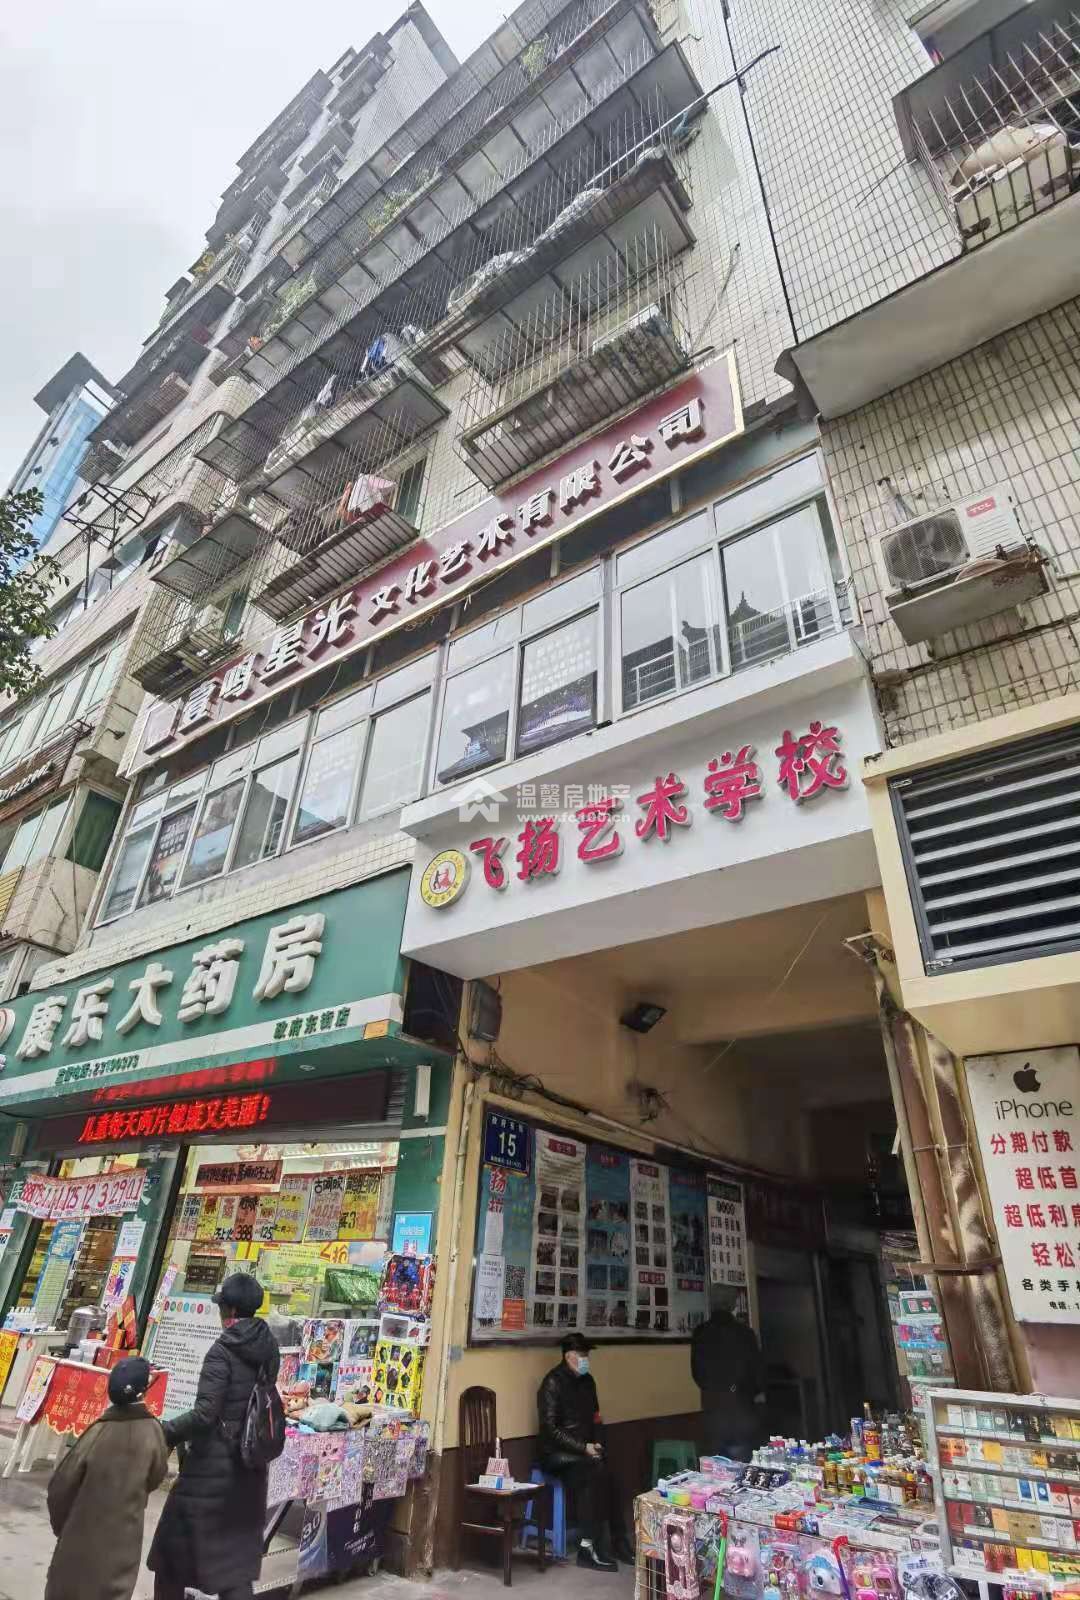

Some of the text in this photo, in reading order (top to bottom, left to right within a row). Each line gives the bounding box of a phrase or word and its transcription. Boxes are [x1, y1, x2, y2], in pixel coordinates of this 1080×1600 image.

[970, 502, 993, 514] TCL
[470, 721, 849, 892] 飞扬艺术学校
[15, 912, 328, 1061] 康乐大药房
[994, 1098, 1074, 1121] iPhone
[499, 1131, 517, 1157] 15
[990, 1129, 1074, 1155] 分期付款
[1014, 1165, 1079, 1190] 超低首
[1030, 1242, 1080, 1268] 轻松
